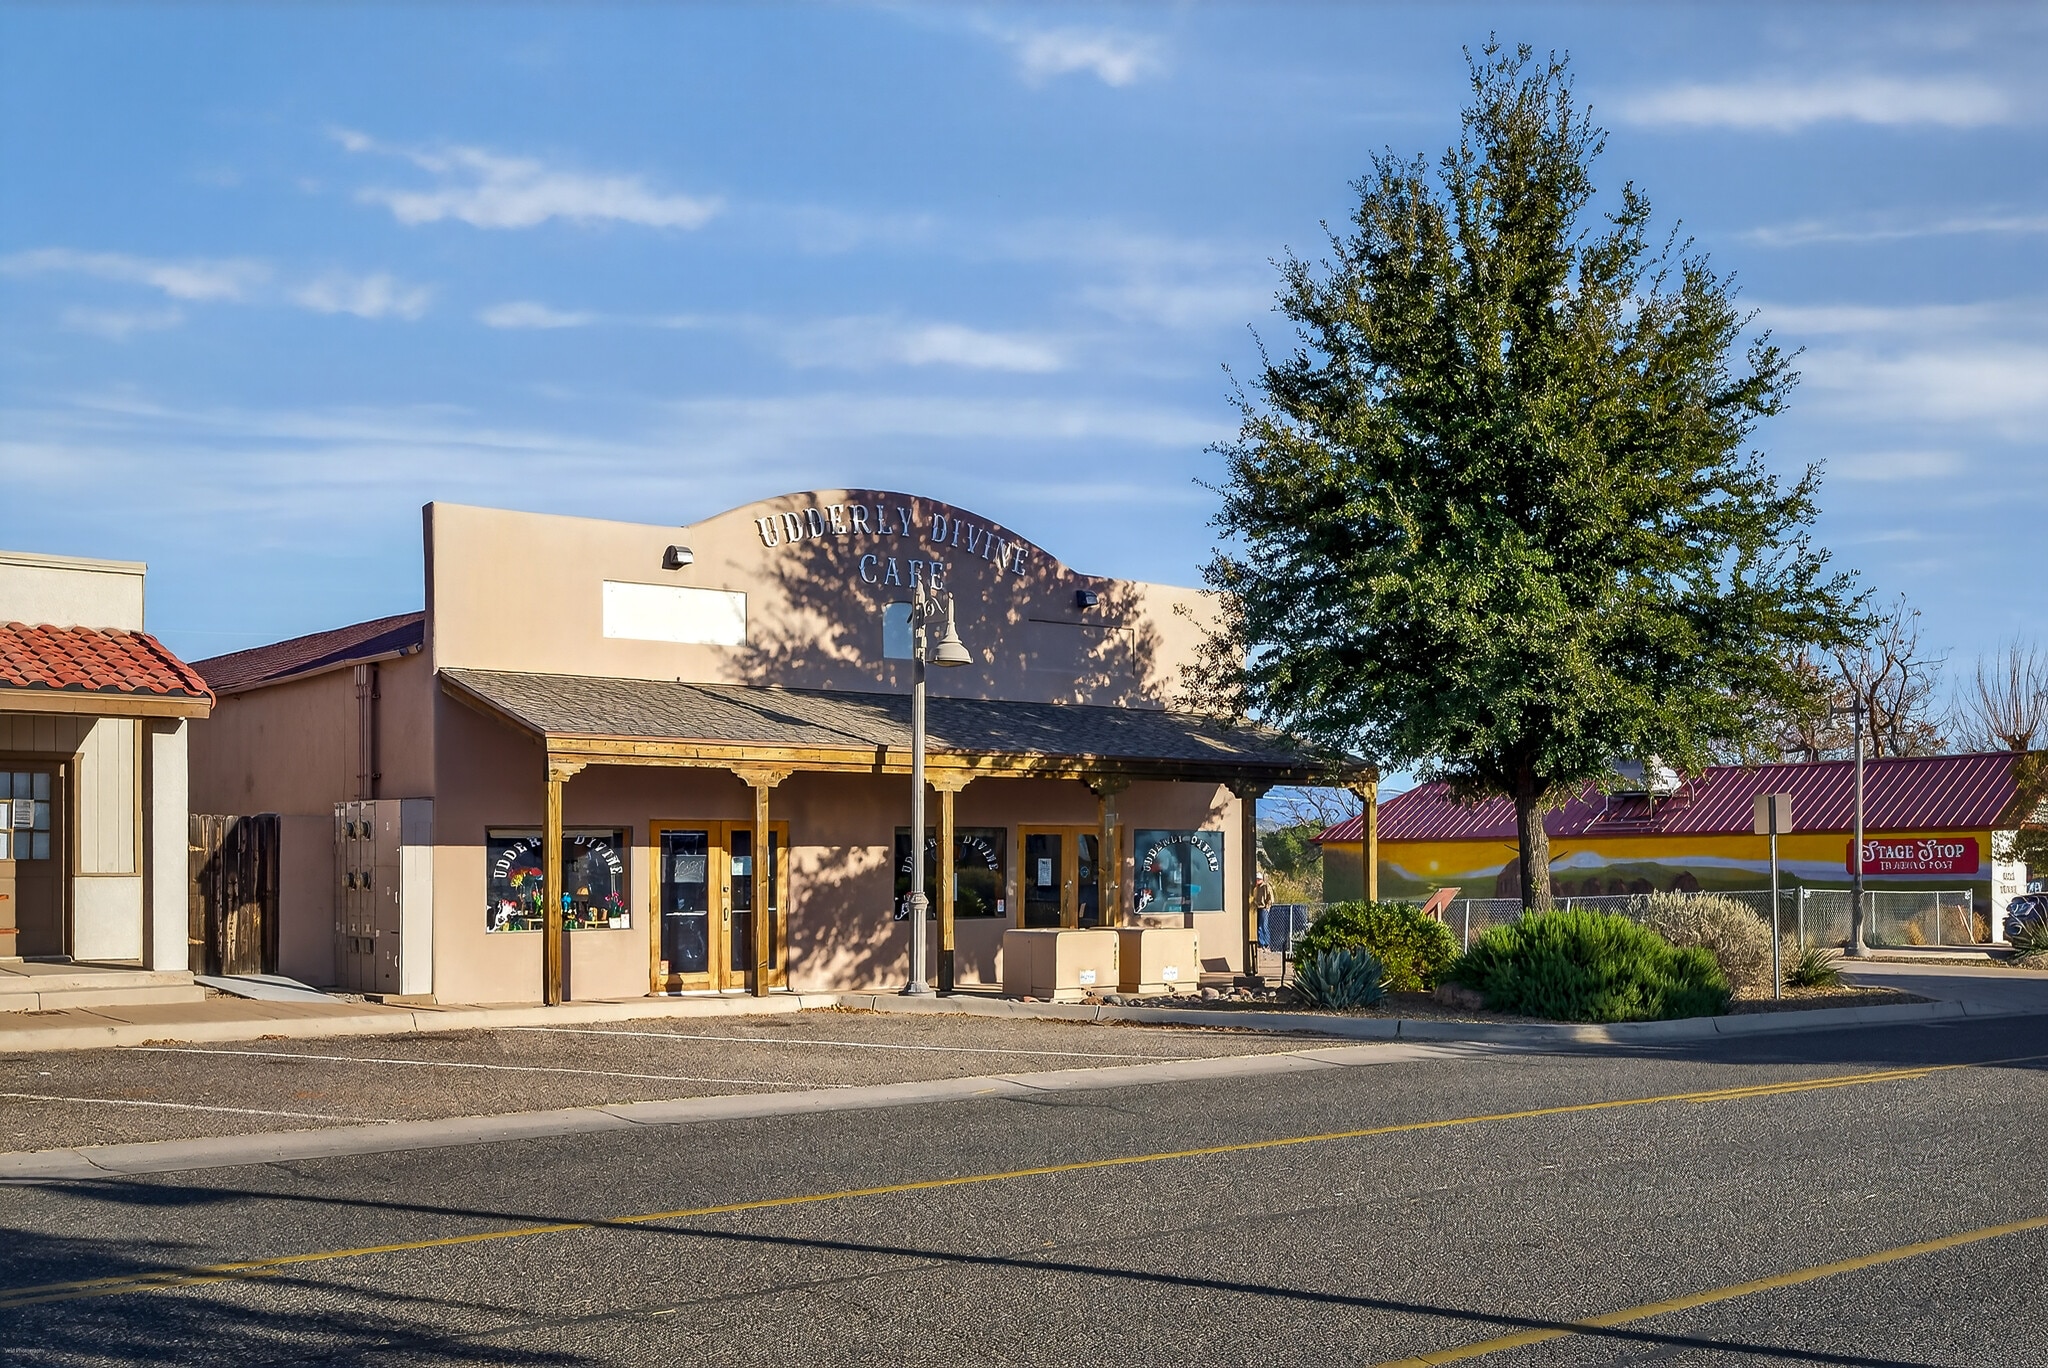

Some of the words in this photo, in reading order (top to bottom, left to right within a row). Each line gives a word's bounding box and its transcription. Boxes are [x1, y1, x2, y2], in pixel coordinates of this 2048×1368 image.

[755, 503, 912, 547] UDDERLY
[931, 513, 1029, 576] DIVINE
[859, 554, 944, 590] CAFE
[493, 836, 541, 879] UDDER
[574, 835, 623, 874] DIVINE
[1917, 840, 1965, 861] STOP
